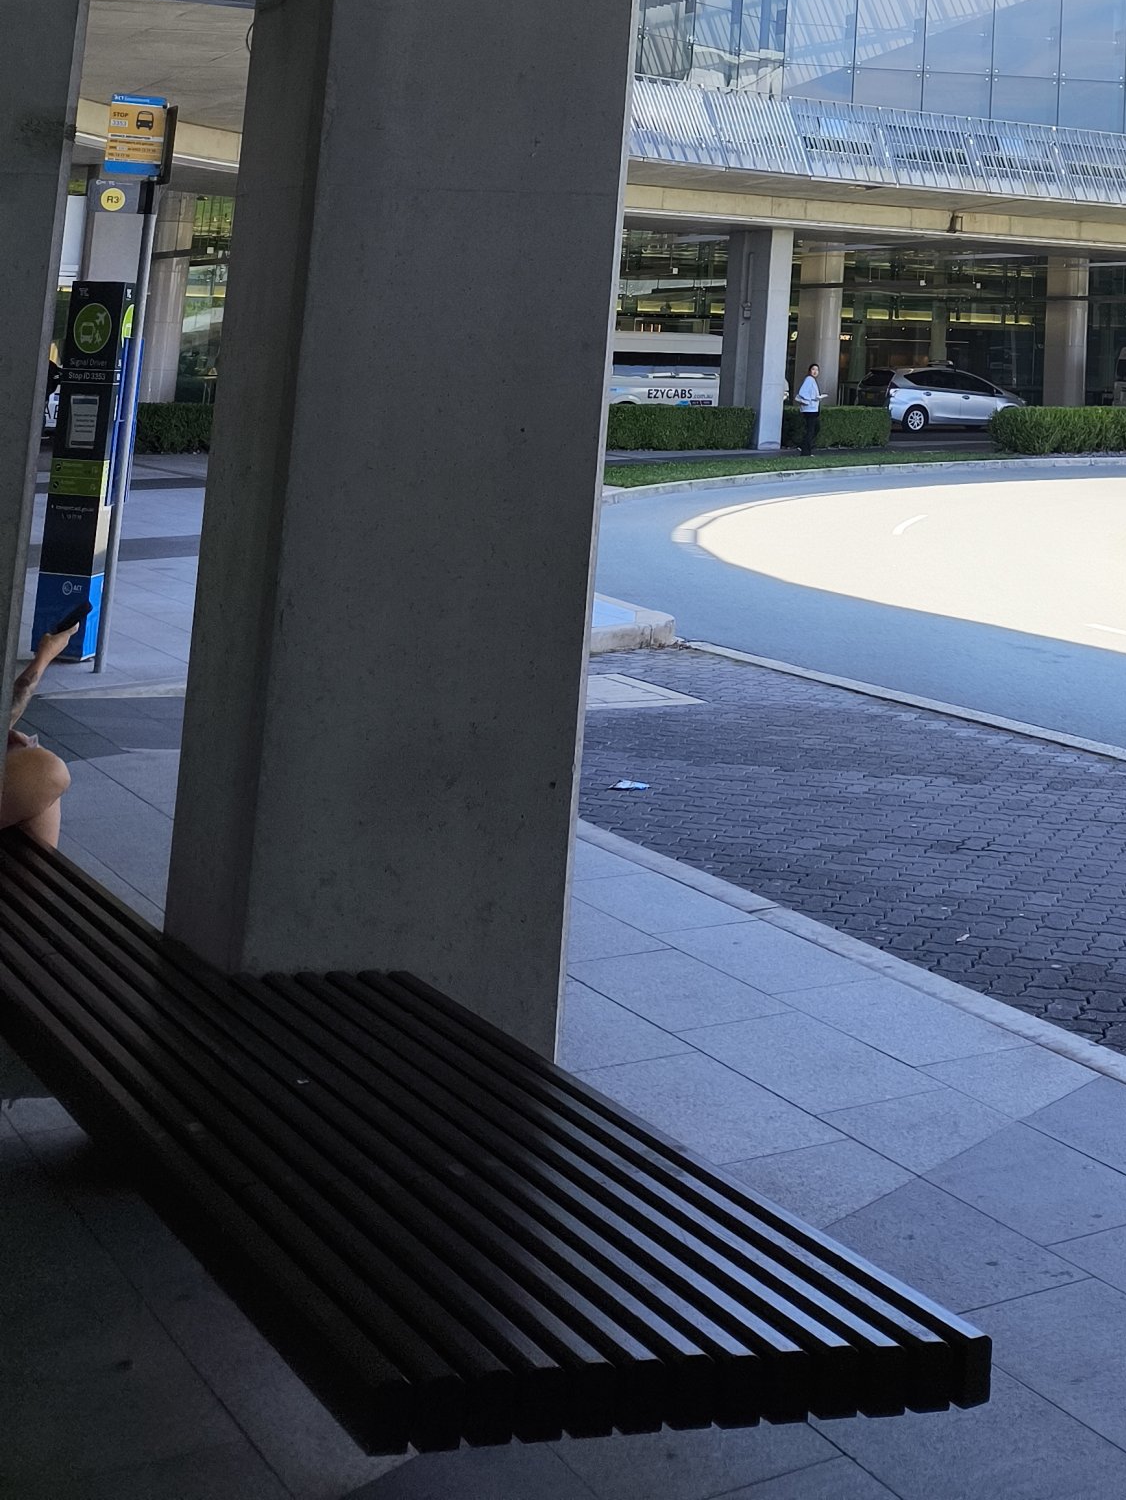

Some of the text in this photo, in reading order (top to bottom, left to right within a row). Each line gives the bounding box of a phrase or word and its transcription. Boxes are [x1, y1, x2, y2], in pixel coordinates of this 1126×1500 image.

[106, 195, 119, 204] R3
[70, 358, 88, 367] Signal
[89, 358, 107, 367] Driver
[68, 372, 83, 380] Stop
